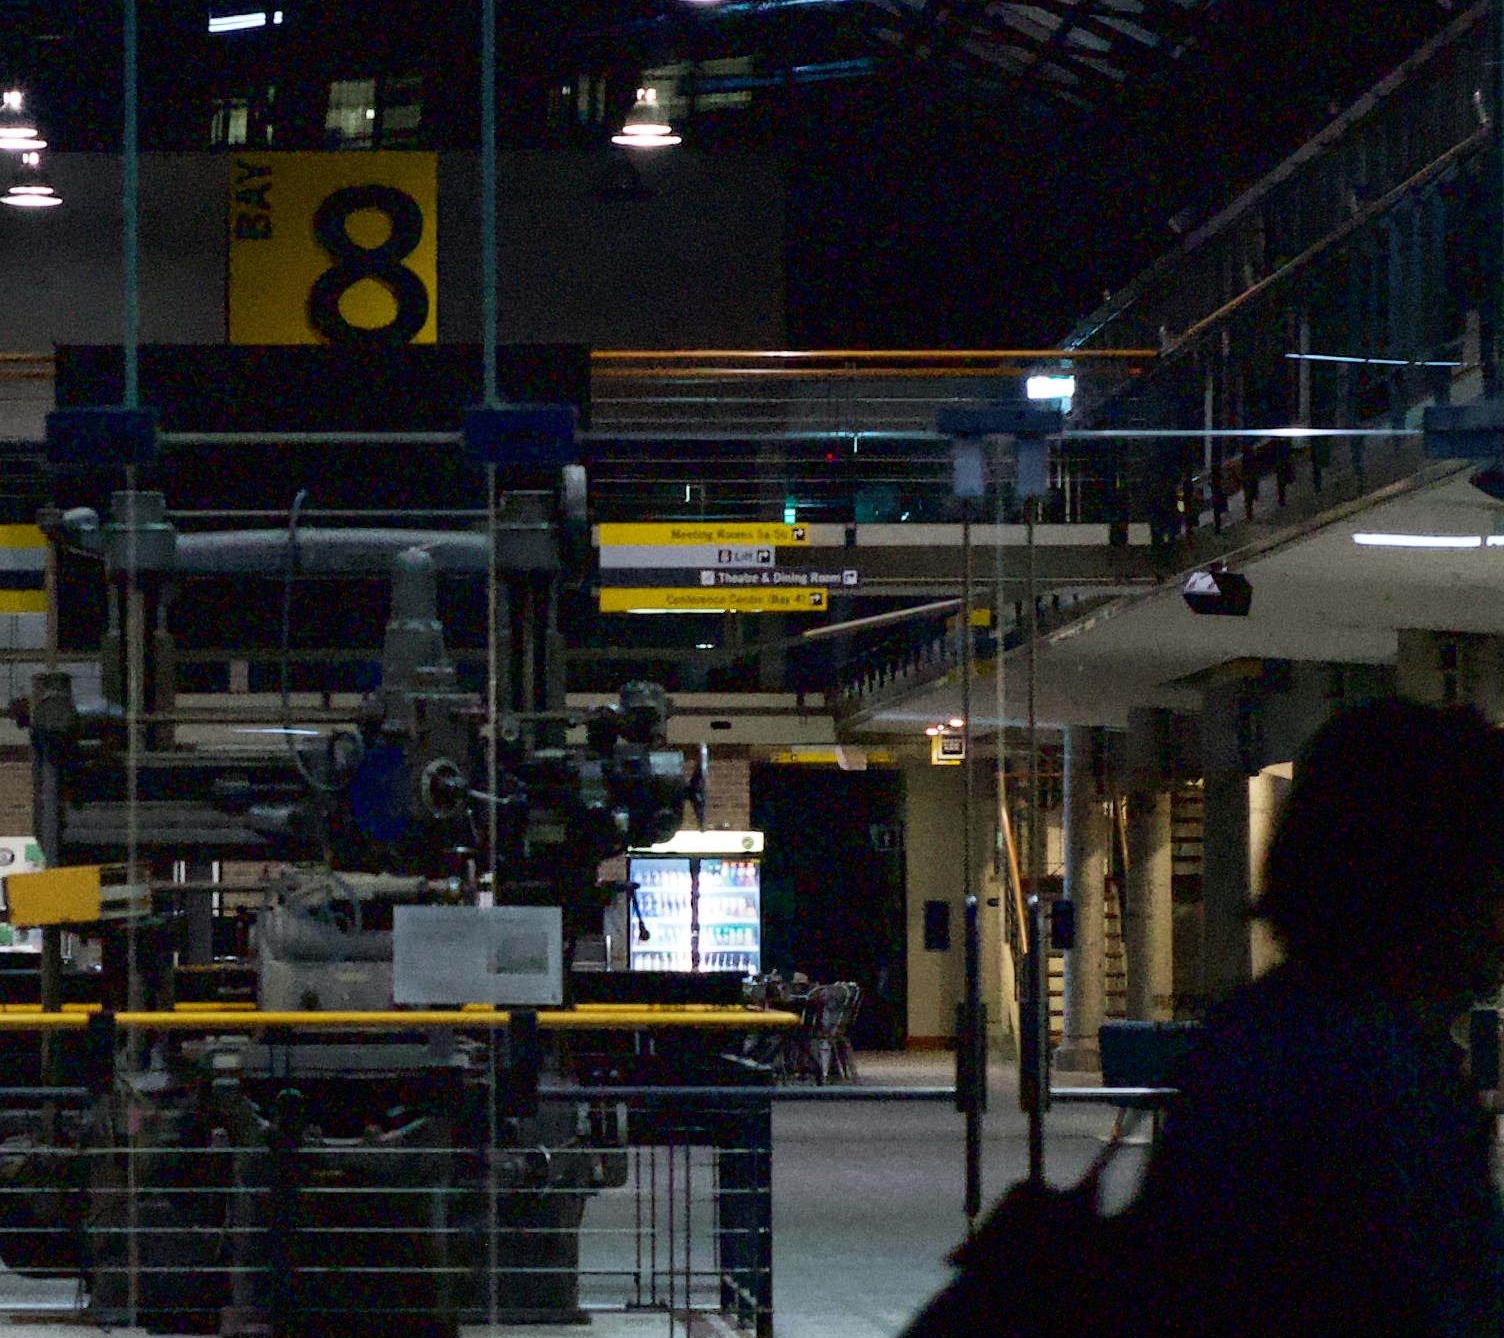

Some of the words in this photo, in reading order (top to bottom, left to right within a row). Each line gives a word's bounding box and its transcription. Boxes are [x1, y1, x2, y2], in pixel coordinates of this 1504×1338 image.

[236, 159, 272, 240] BAY
[309, 184, 428, 347] 8
[773, 571, 808, 585] Dining
